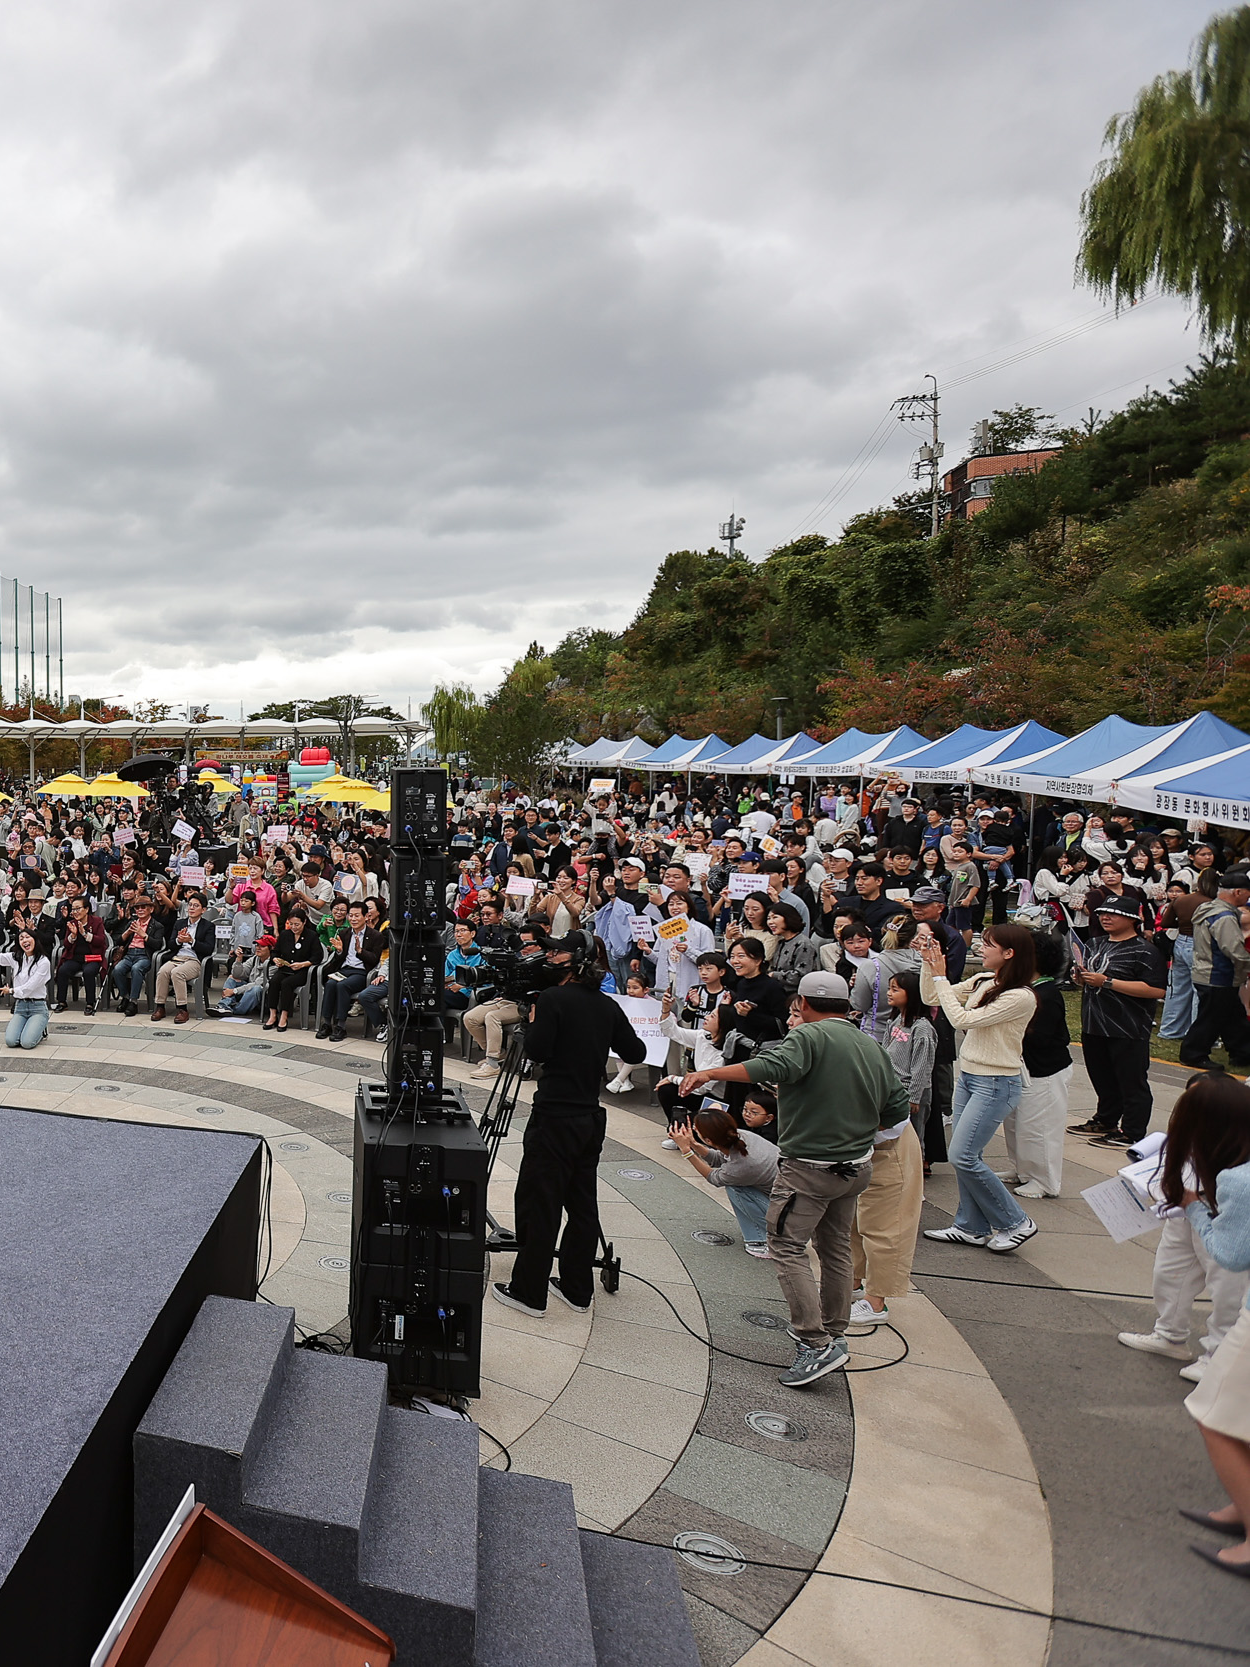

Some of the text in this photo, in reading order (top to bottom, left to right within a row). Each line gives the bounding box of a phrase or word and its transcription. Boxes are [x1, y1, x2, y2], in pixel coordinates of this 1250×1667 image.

[1046, 780, 1094, 796] 지역사회보장협의체
[1156, 794, 1250, 823] 광장동 문화행사위원회
